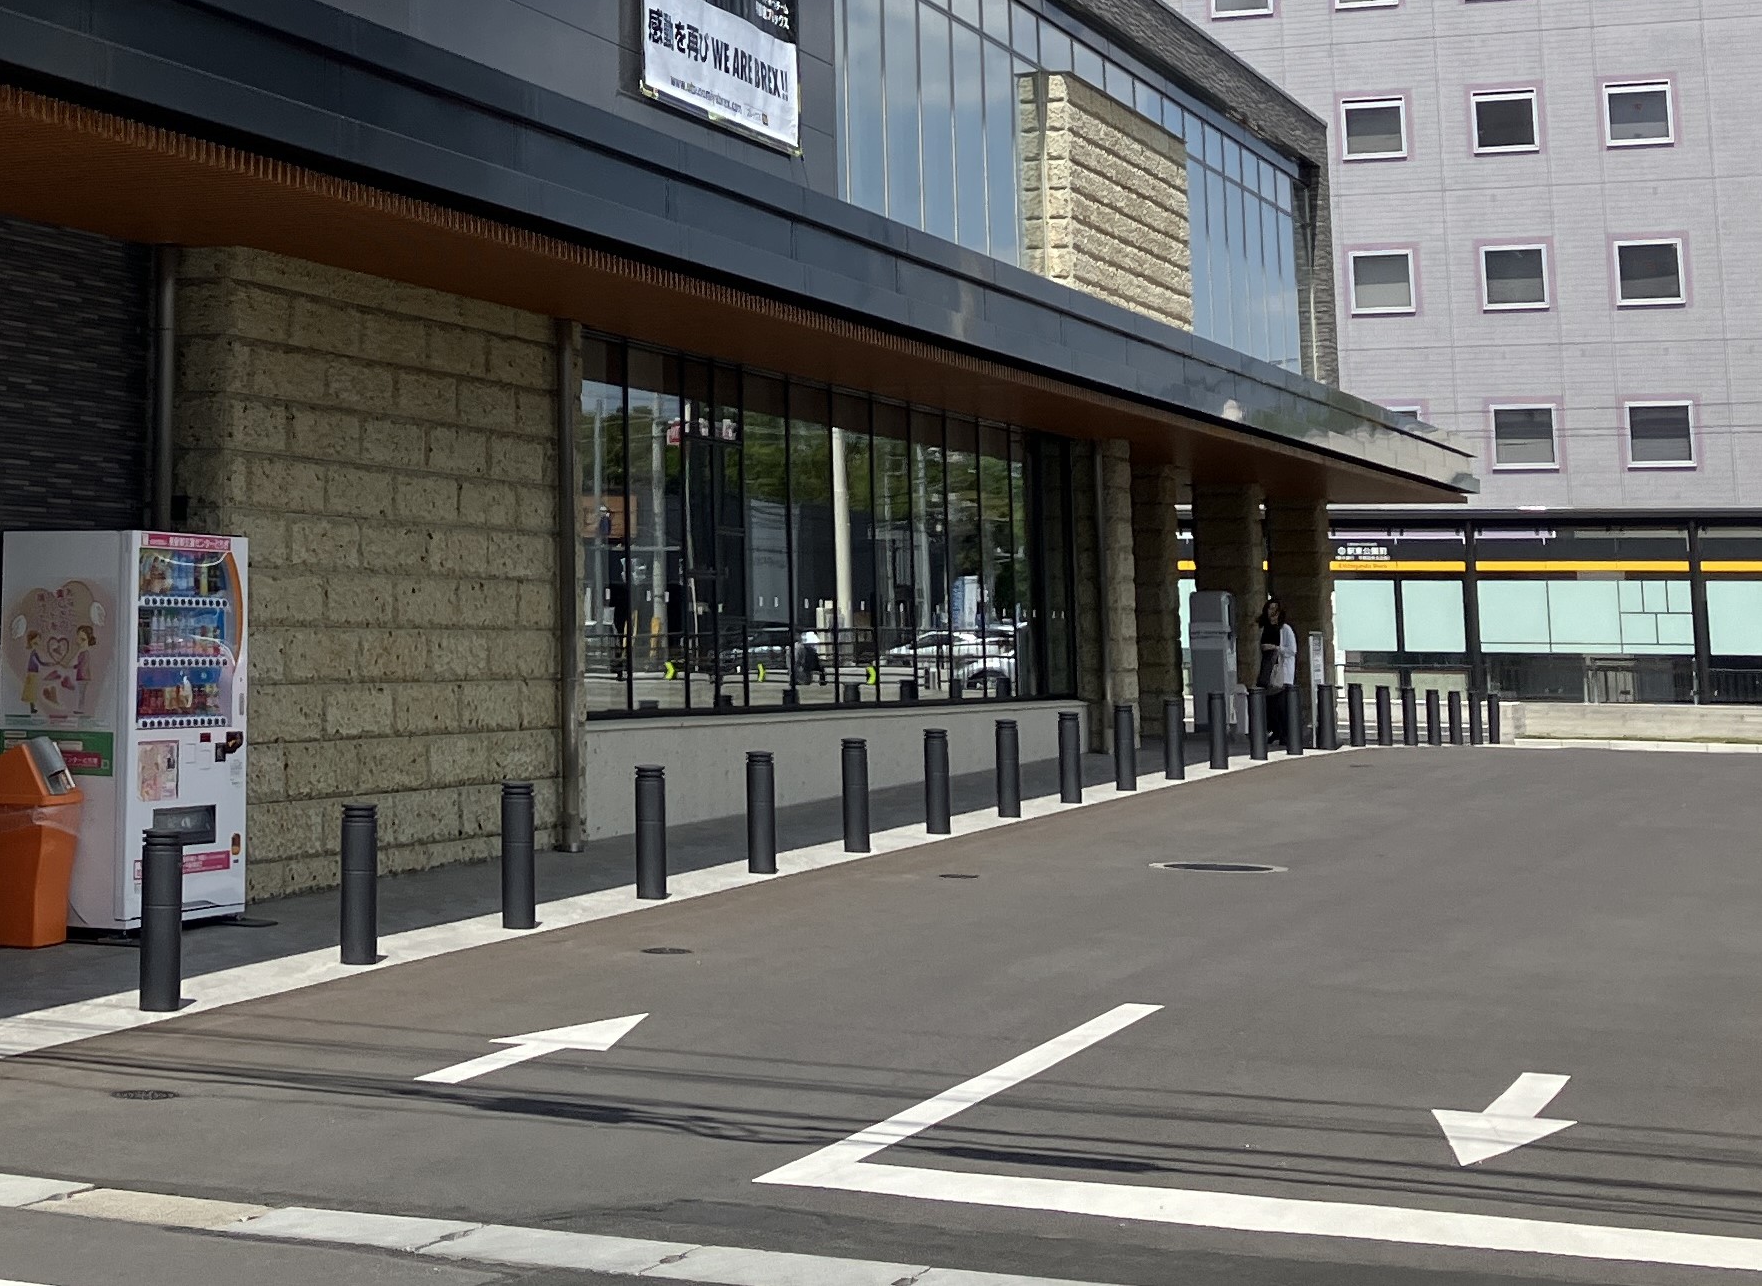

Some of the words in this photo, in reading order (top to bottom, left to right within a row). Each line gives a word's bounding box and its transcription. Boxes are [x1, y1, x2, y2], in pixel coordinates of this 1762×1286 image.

[649, 8, 709, 63] 感動を再び
[712, 36, 730, 74] WE
[733, 47, 753, 85] ARE
[755, 57, 781, 98] BREX
